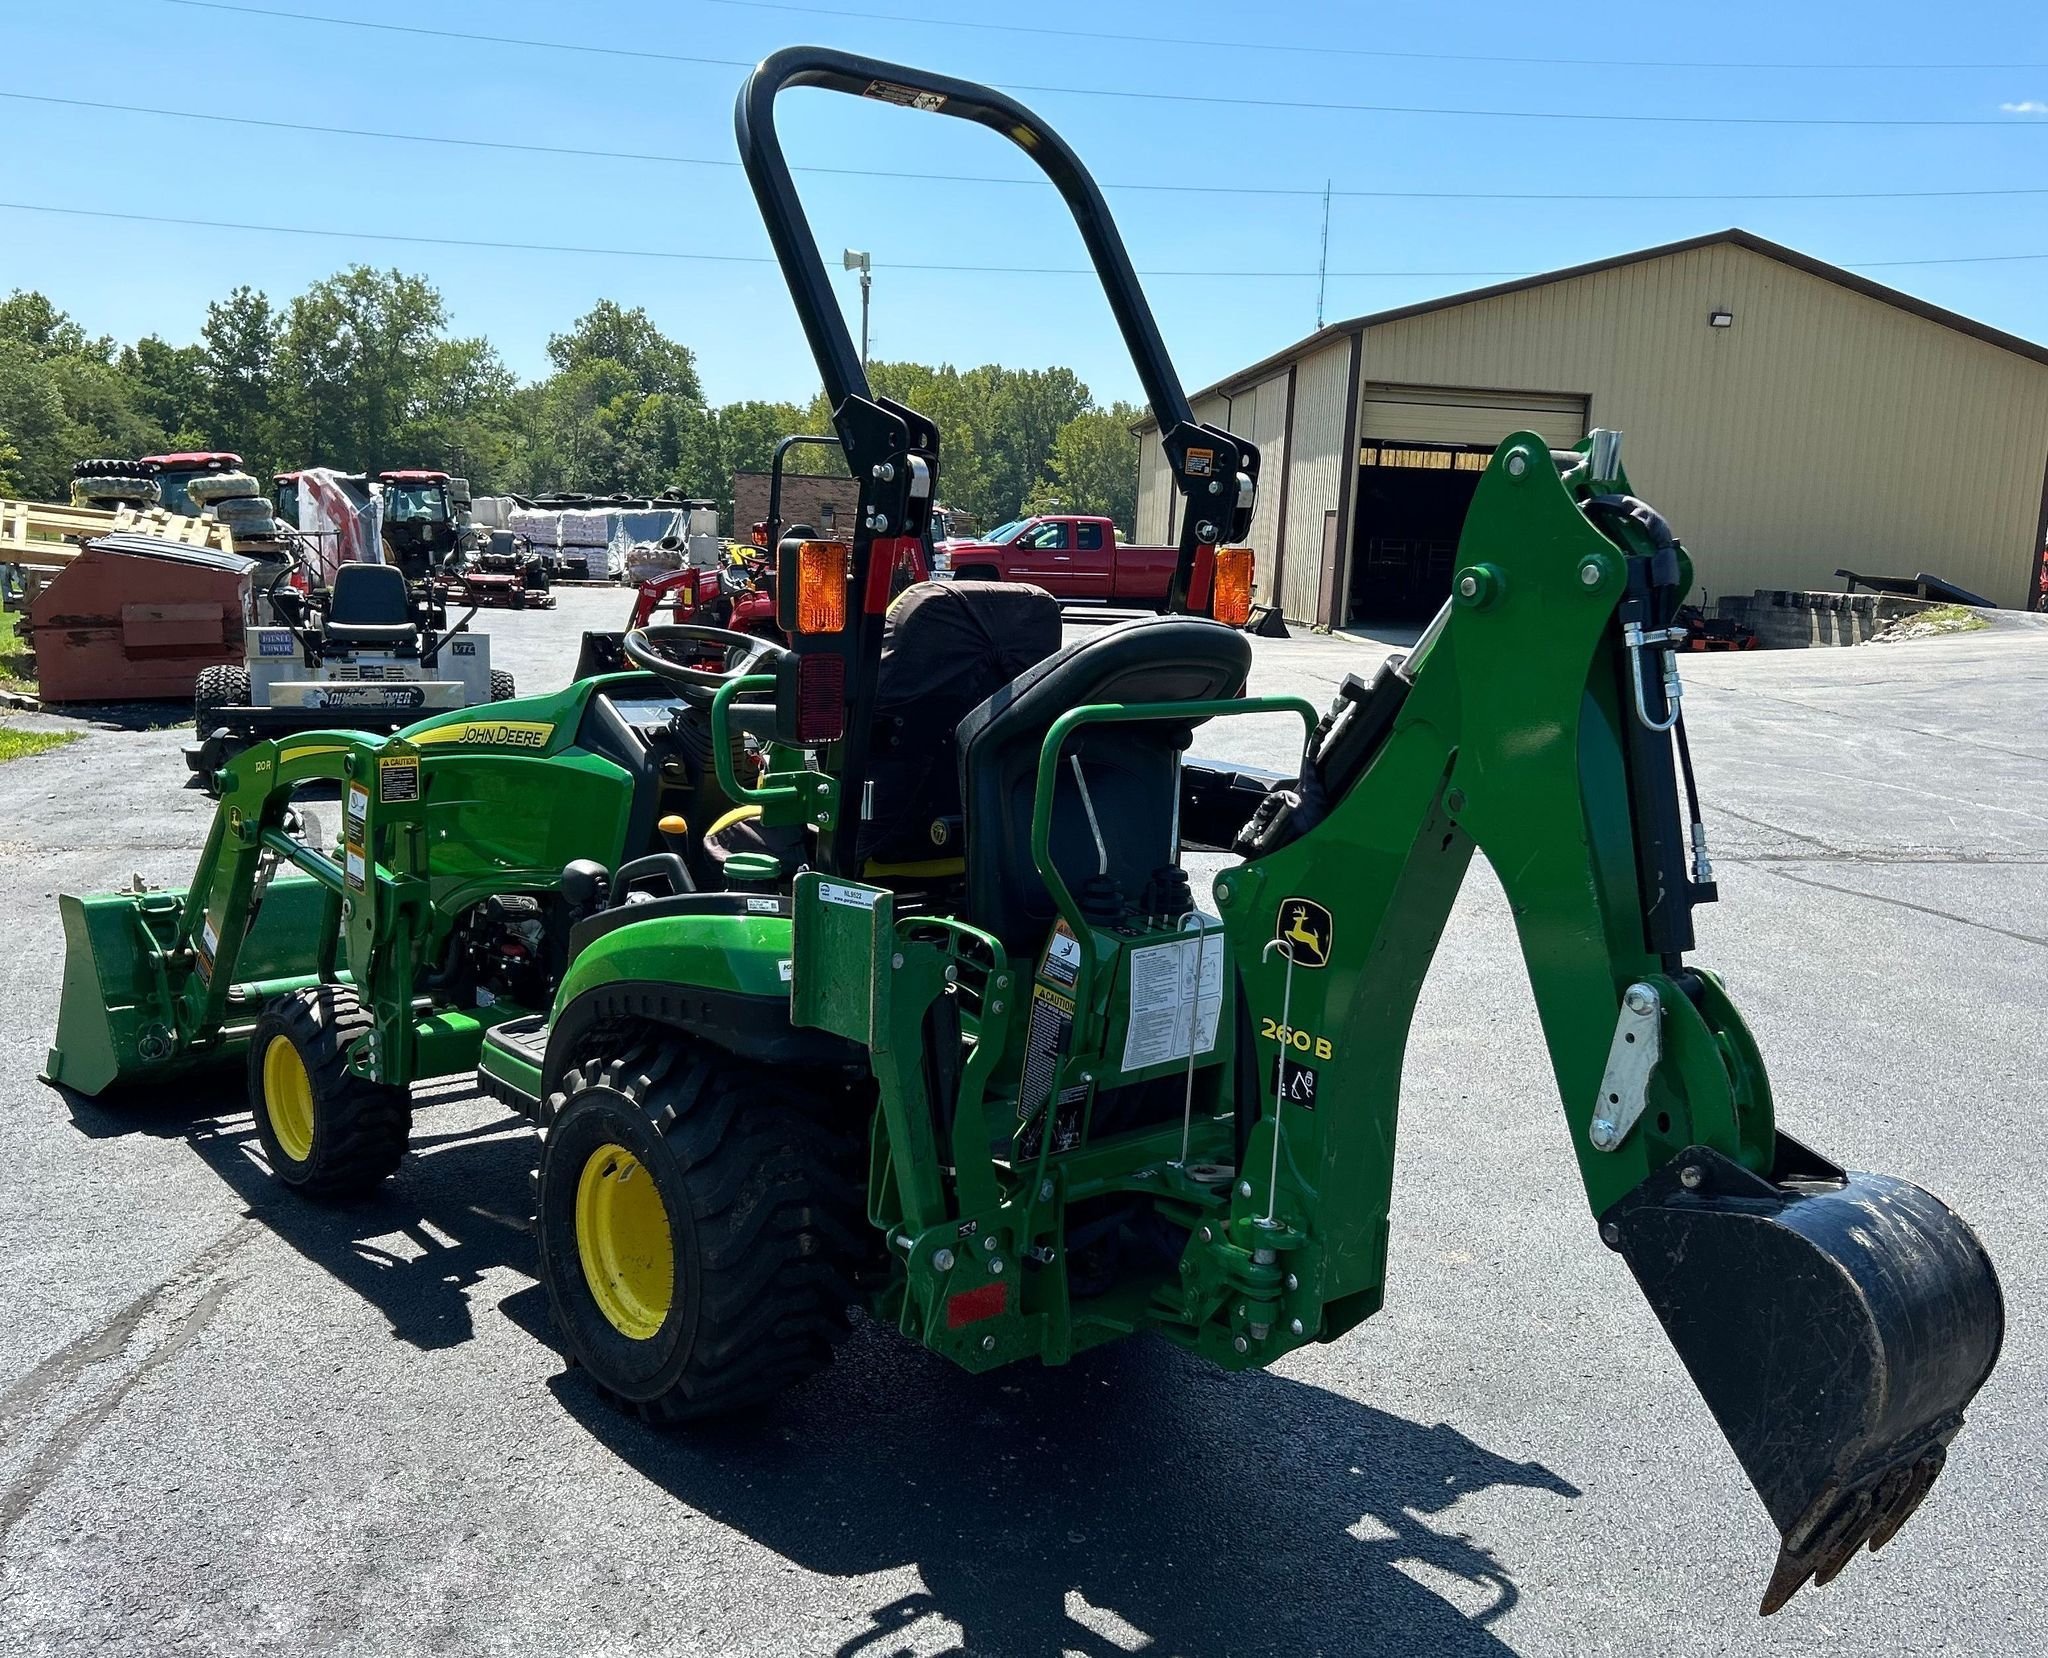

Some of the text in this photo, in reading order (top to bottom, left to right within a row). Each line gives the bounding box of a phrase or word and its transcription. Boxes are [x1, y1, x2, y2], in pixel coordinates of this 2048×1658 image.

[459, 725, 543, 746] JOHN DEERE
[390, 757, 417, 766] CAUTION
[1046, 991, 1074, 1013] CAUTION
